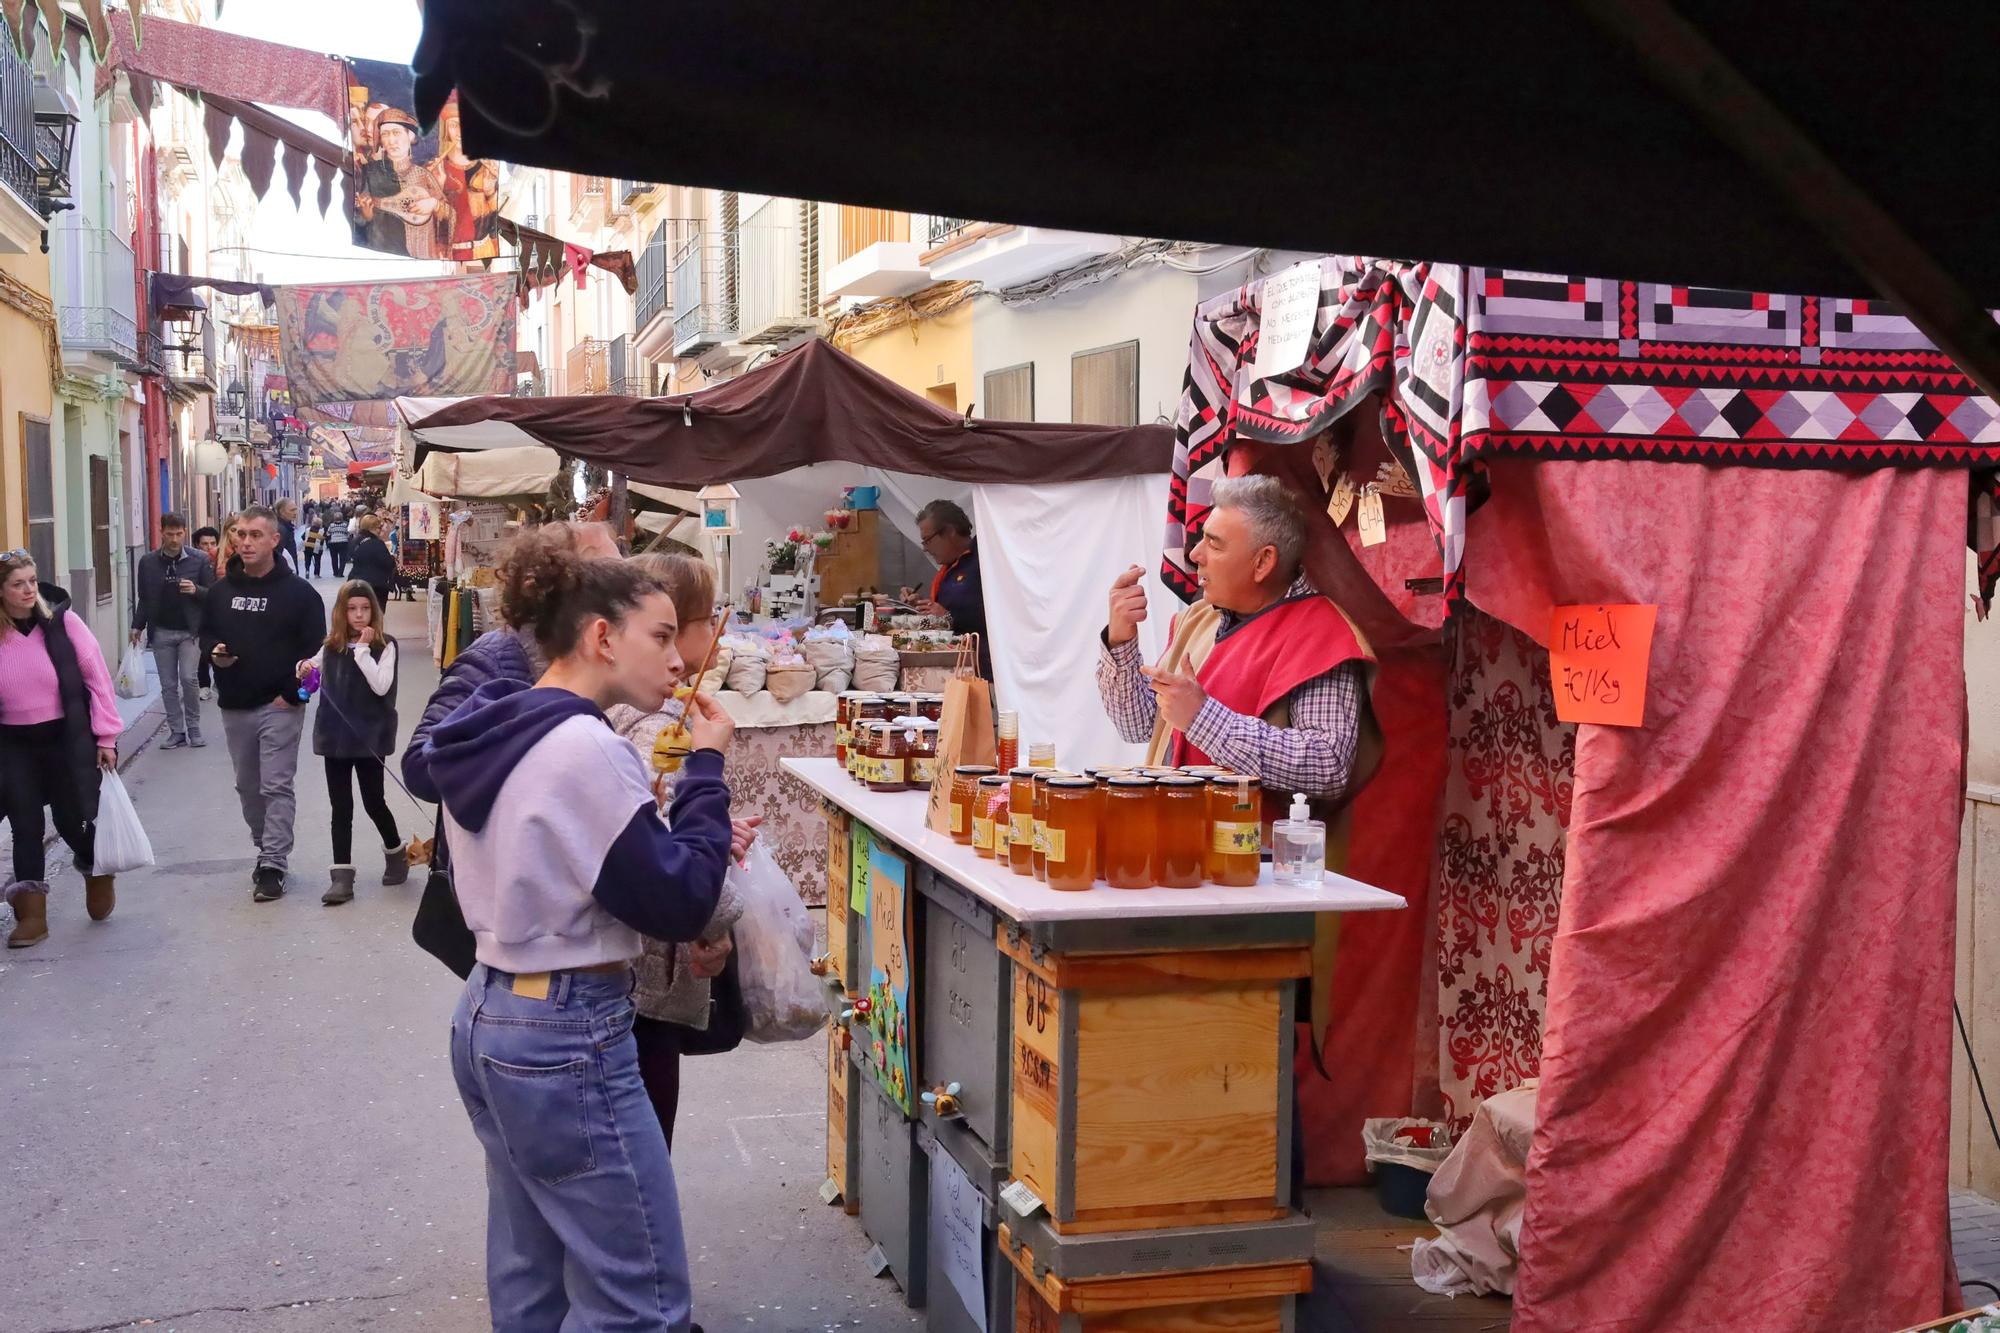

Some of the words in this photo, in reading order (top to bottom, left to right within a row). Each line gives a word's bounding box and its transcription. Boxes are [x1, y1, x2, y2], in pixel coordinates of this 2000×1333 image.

[1266, 318, 1277, 329] NO
[1359, 507, 1383, 531] CHA
[231, 597, 267, 611] TUPAC
[1562, 610, 1621, 651] Miel
[875, 887, 897, 933] Miel
[1026, 971, 1046, 1034] GB
